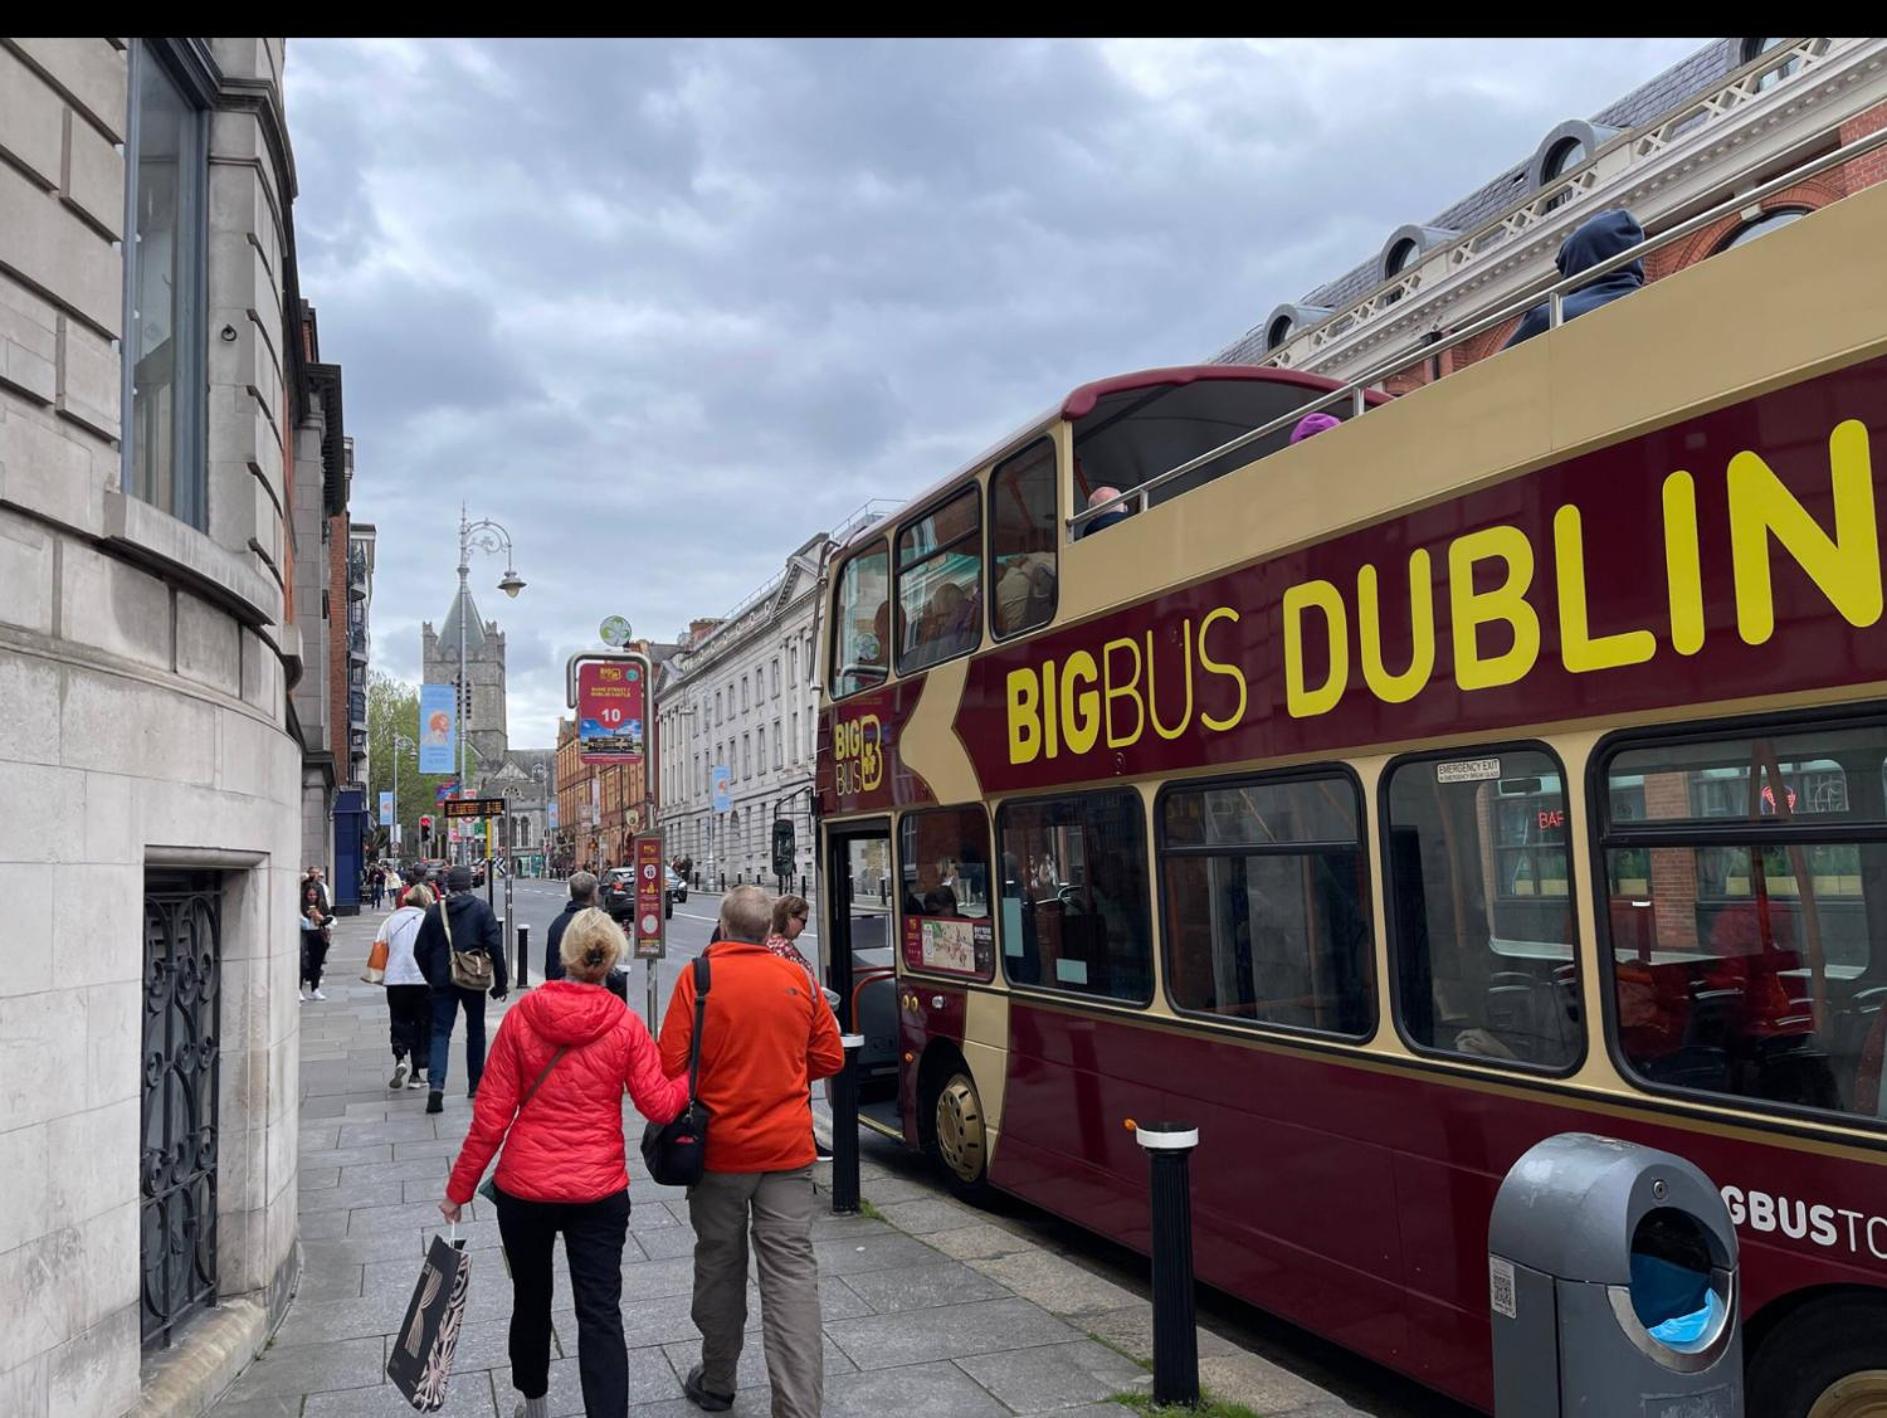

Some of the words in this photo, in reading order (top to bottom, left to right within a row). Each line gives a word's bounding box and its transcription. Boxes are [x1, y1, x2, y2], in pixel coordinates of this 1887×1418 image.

[1283, 419, 1884, 718] DUBLIN
[601, 708, 621, 722] 10
[835, 719, 860, 760] BIG
[836, 760, 861, 795] BUS
